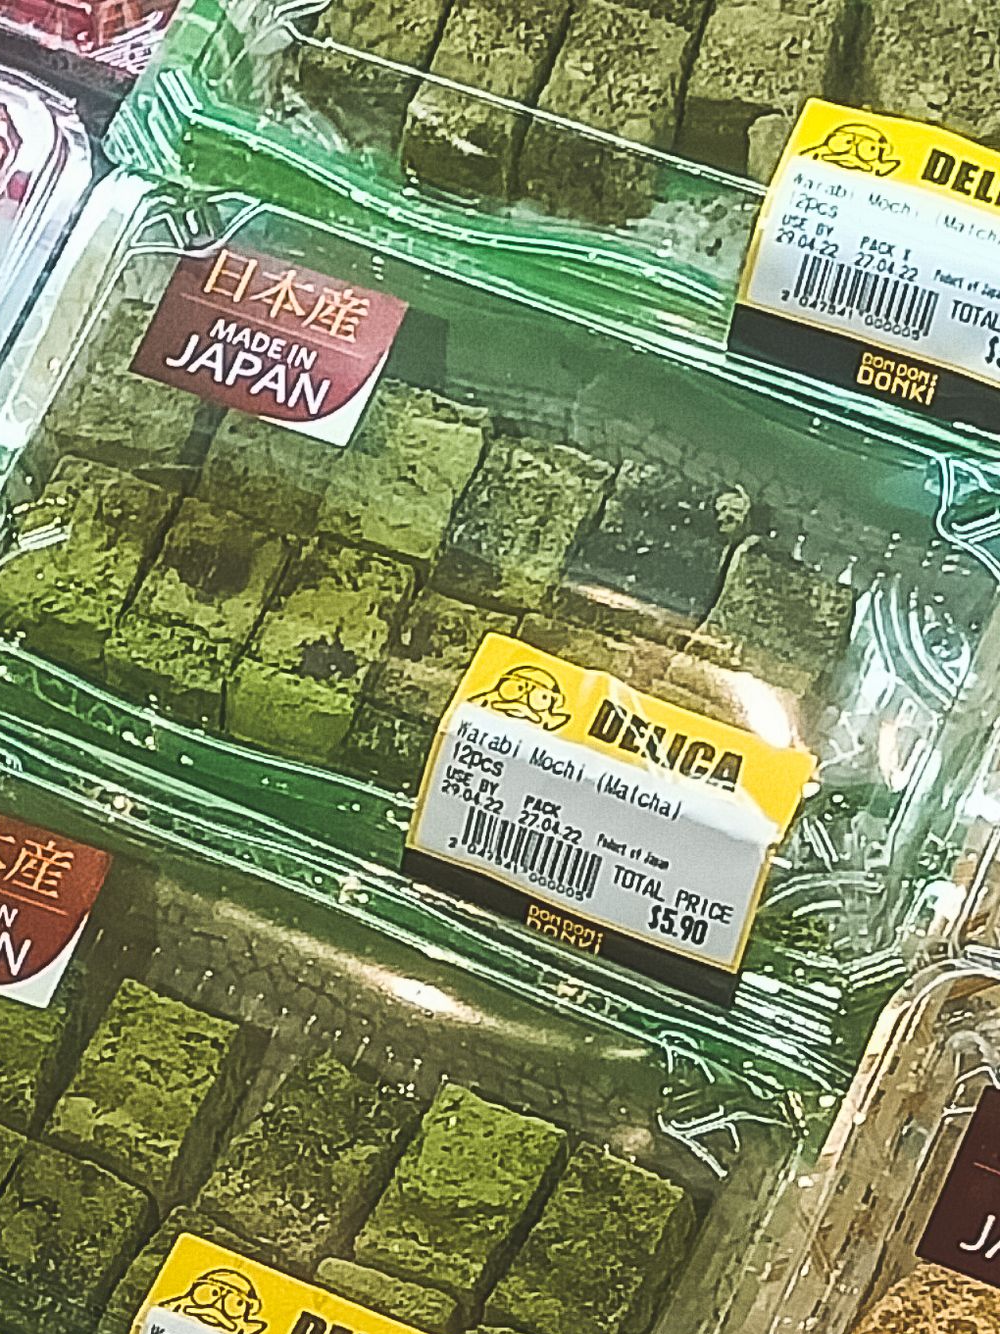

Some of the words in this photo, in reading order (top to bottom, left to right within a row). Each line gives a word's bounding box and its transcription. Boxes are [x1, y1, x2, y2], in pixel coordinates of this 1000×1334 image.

[921, 147, 1000, 206] DEL
[781, 214, 808, 231] USE
[790, 191, 838, 219] 12pcs
[854, 251, 919, 282] 27.04.22
[203, 249, 370, 344] 日本産
[210, 318, 288, 360] MADE
[287, 344, 318, 371] IN
[165, 334, 331, 415] JAPAN
[856, 366, 938, 405] DONKI
[453, 741, 504, 777] 12pcs
[457, 720, 523, 758] Warabi
[529, 747, 586, 782] Mochi
[597, 771, 683, 821] (Matcha)
[588, 699, 744, 792] DELICA
[446, 765, 474, 786] USE
[479, 778, 500, 796] BY
[523, 795, 561, 818] PACK
[518, 810, 583, 845] 27.04.22
[614, 864, 665, 902] TOTAL
[675, 889, 734, 925] PRICE
[648, 904, 708, 946] $5.90
